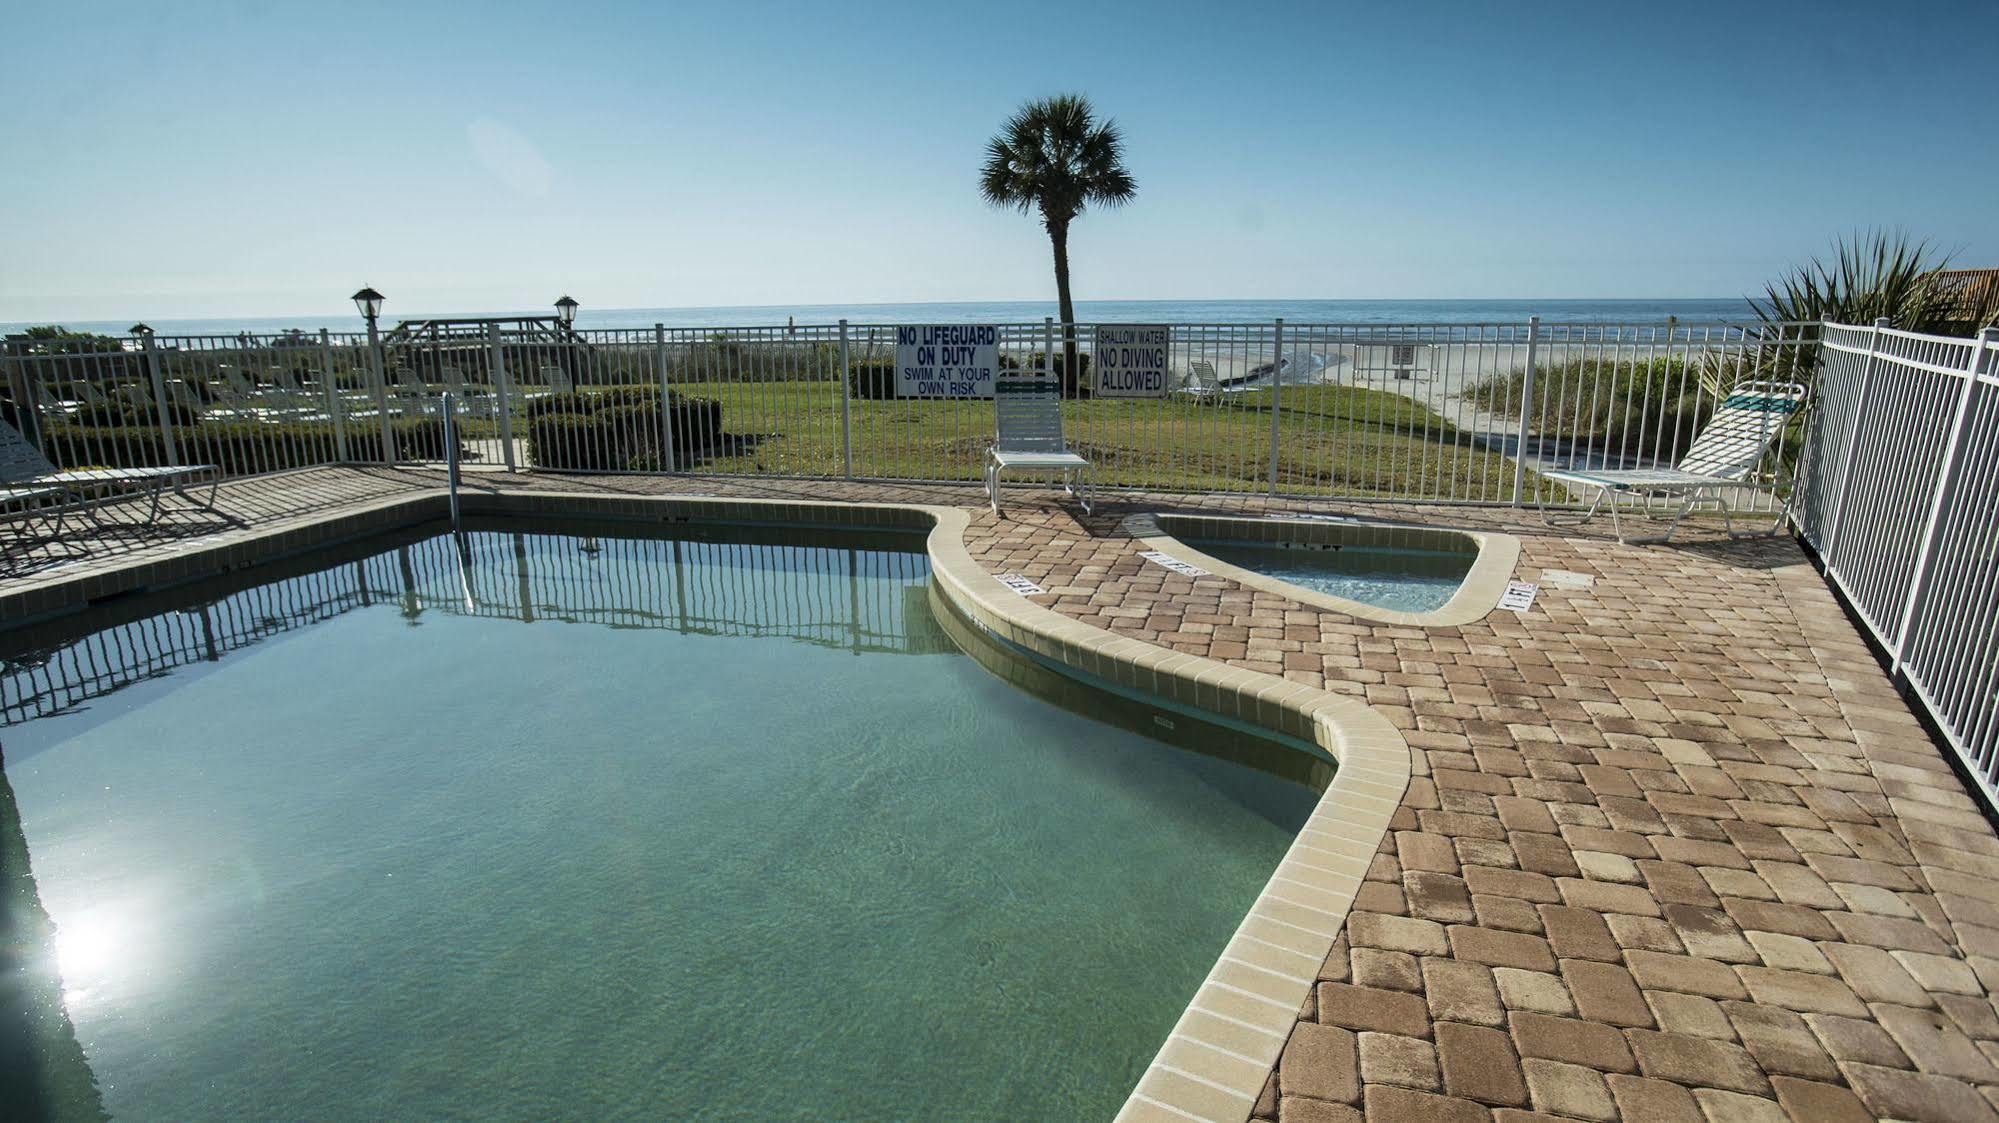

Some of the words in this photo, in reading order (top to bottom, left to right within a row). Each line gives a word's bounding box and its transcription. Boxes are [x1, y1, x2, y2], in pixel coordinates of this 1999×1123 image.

[899, 326, 917, 345] NO
[923, 326, 995, 345] LIFEGUARD
[1101, 330, 1136, 344] SHALLOW
[1139, 330, 1165, 345] WATER
[917, 346, 935, 366] ON
[942, 346, 976, 366] DUTY
[1101, 347, 1117, 369] NO
[1121, 347, 1164, 370] DIVING
[904, 367, 934, 381] SWIM
[938, 367, 953, 381] AT
[959, 367, 991, 382] YOUR
[1101, 370, 1162, 391] ALLOWED
[918, 381, 945, 395] OWN
[950, 381, 976, 395] RISK
